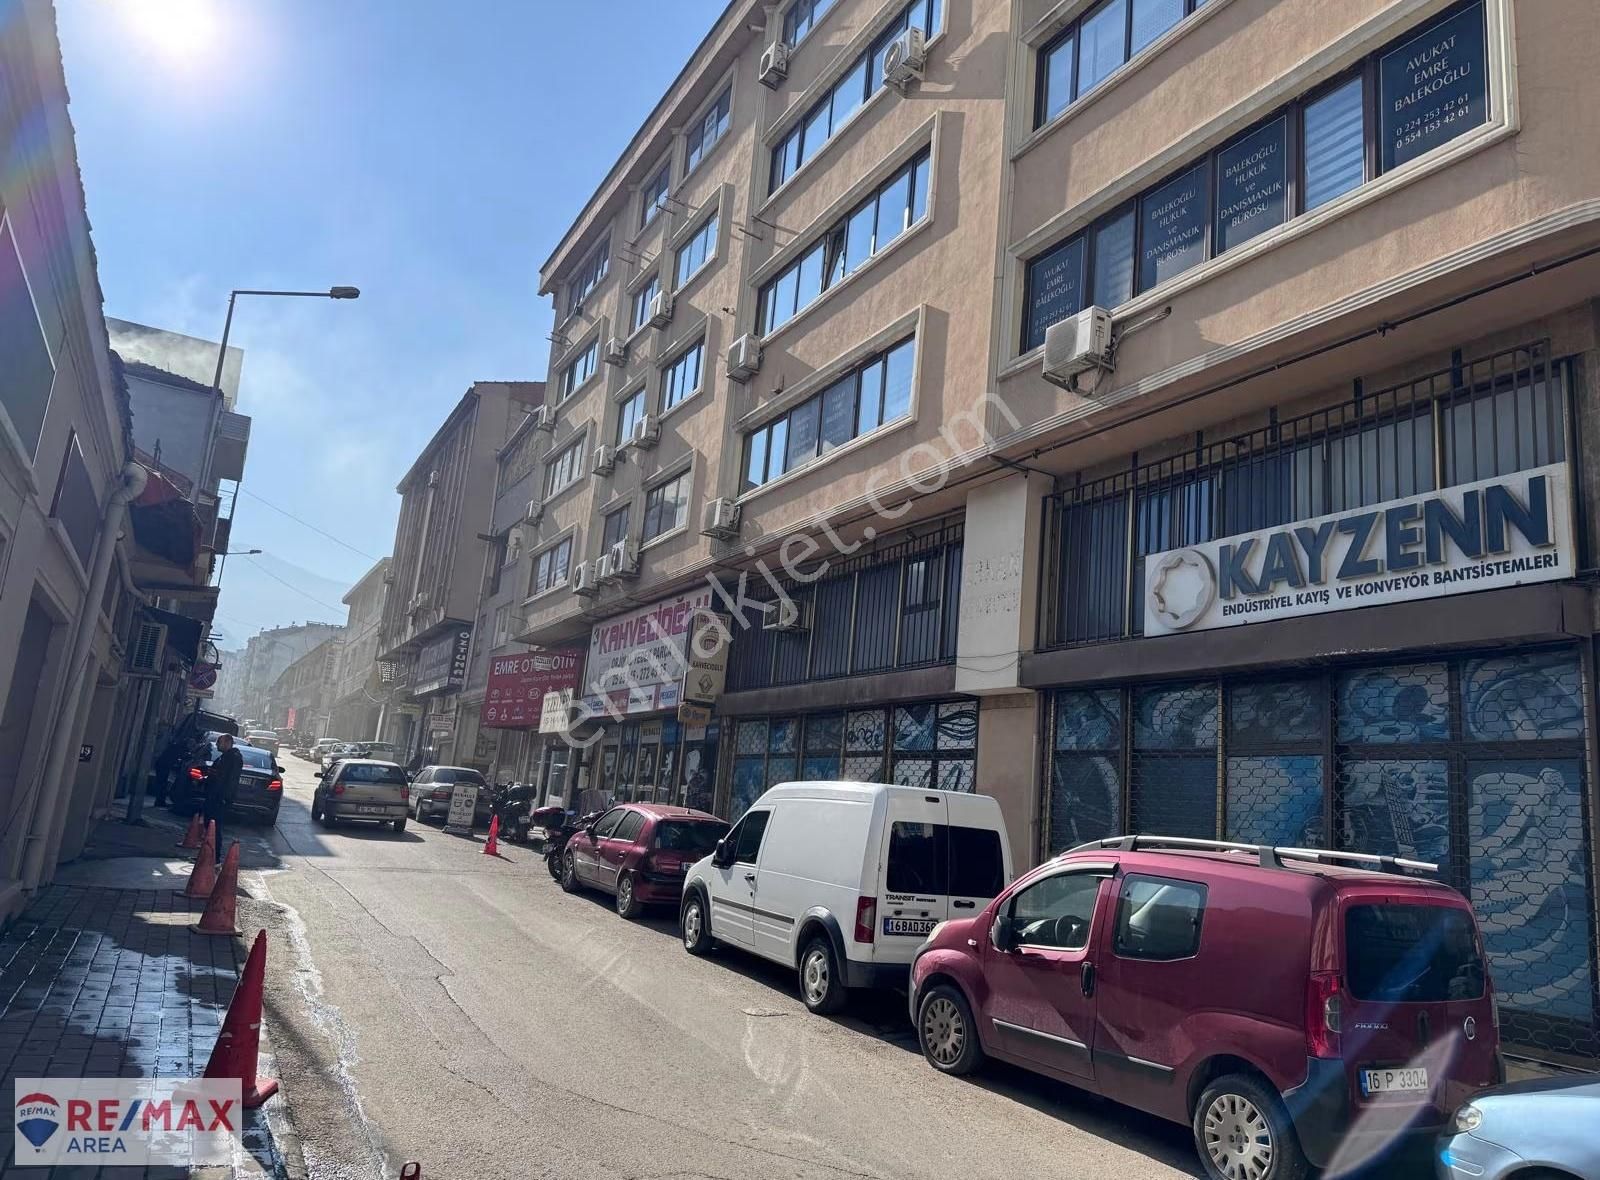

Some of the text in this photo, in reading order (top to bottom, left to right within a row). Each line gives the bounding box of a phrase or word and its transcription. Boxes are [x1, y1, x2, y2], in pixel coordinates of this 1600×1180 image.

[1406, 34, 1457, 72] AVUKAT
[1414, 56, 1449, 85] EMRE
[1394, 62, 1471, 112] BALEKOĞLU
[1396, 92, 1469, 136] 0 224 253 42 61
[1396, 139, 1403, 149] 0
[1425, 119, 1441, 134] 153
[1443, 112, 1455, 124] 42
[1458, 105, 1469, 117] 61
[1225, 142, 1278, 178] BALEKOĞLU
[1235, 162, 1268, 186] HUKUK
[1244, 181, 1256, 193] ve
[1159, 207, 1188, 229] HUKUK
[1231, 200, 1269, 228] BÜROSU
[1043, 258, 1070, 279] AVUKAT
[1218, 474, 1556, 600] KAYZENN
[1222, 548, 1559, 617] ENDÜSTRİYEL KAYIŞ VE KONVEYÖR BANTSİSTEMLERİ
[493, 659, 520, 676] EMRE
[521, 650, 577, 673] OTOTİV
[885, 894, 916, 902] TRANSIT
[1367, 1070, 1427, 1089] 16 P 3304
